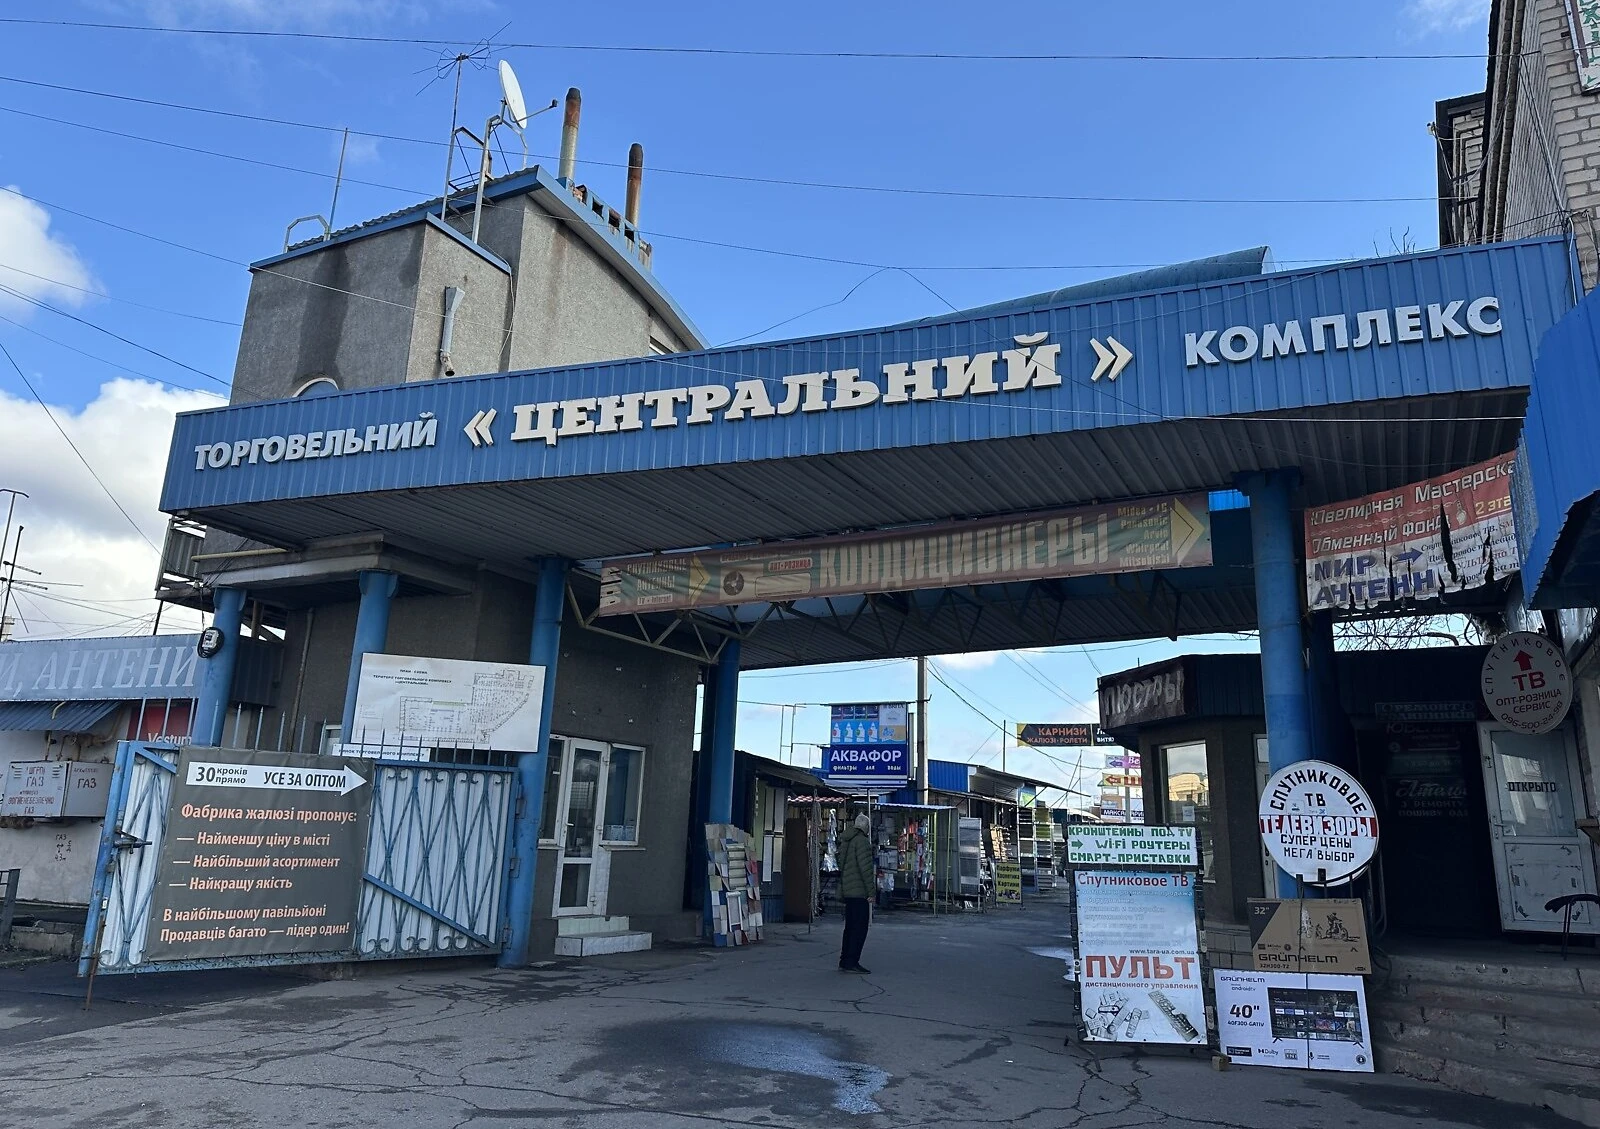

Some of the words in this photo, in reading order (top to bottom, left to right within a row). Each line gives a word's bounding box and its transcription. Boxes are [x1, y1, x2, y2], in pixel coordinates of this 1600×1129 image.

[194, 411, 438, 470] ТОРГОВЕЛЬНИЙ
[1184, 296, 1503, 368] КОМПЛЕКС
[1475, 501, 1485, 516] 2
[1312, 524, 1399, 554] Обменный
[819, 513, 1108, 589] КОНДИЦИОНЕРЫ
[1314, 555, 1378, 582] МИР
[1314, 568, 1436, 606] АНТЕНН
[31, 645, 199, 690] АНТЕНИ
[1512, 671, 1546, 691] ТВ
[1496, 688, 1562, 707] ОПТ-РОЗНИЦА
[1513, 701, 1551, 714] СЕРВИС
[147, 732, 193, 746] Vestum
[1038, 727, 1087, 736] КАРНИЗИ
[830, 749, 902, 763] АКВАФОР
[195, 766, 216, 782] 30
[216, 767, 248, 776] кроків
[263, 771, 285, 785] УСЕ
[286, 772, 302, 786] ЗА
[305, 773, 346, 788] ОПТОМ
[26, 776, 45, 787] ГАЗ
[77, 778, 97, 789] ГАЗ
[215, 777, 246, 785] прямо
[1508, 781, 1557, 792] ОТКРЫТО
[1270, 769, 1368, 814] СПУТНИКОВОЕ
[1304, 793, 1326, 806] ТВ
[181, 803, 244, 821] Фабрика
[245, 805, 294, 821] жалюзі
[296, 810, 357, 824] пропонує:
[1151, 828, 1175, 837] ПОД
[1260, 815, 1372, 837] ТЕЛЕВИЗОРЫ
[197, 831, 264, 848] Найменшу
[265, 834, 292, 848] ціну
[293, 835, 301, 845] в
[303, 833, 330, 846] місті
[1131, 840, 1190, 850] РОУТЕРЫ
[1280, 834, 1317, 846] СУПЕР
[1320, 836, 1352, 848] ЦЕНЫ
[193, 854, 270, 868] Найбільший
[272, 857, 340, 871] асортимент
[1070, 852, 1191, 864] СМАРТ-ПРИСТАВКИ
[1284, 847, 1313, 859] МЕГА
[1317, 850, 1355, 862] ВЫБОР
[189, 877, 255, 893] Найкращу
[255, 877, 293, 889] якість
[1077, 872, 1168, 888] Спутниковое
[1171, 874, 1189, 887] ТВ
[163, 908, 172, 922] В
[174, 907, 261, 924] найбільшому
[262, 904, 327, 918] павільйоні
[1254, 906, 1270, 915] 32"
[160, 926, 226, 944] Продавців
[228, 926, 267, 939] багато
[286, 923, 317, 938] лідер
[319, 922, 350, 935] один!
[1085, 955, 1195, 980] ПУЛЬТ
[1085, 981, 1149, 989] дистанционного
[1151, 982, 1199, 990] управления
[1230, 1004, 1260, 1018] 40"
